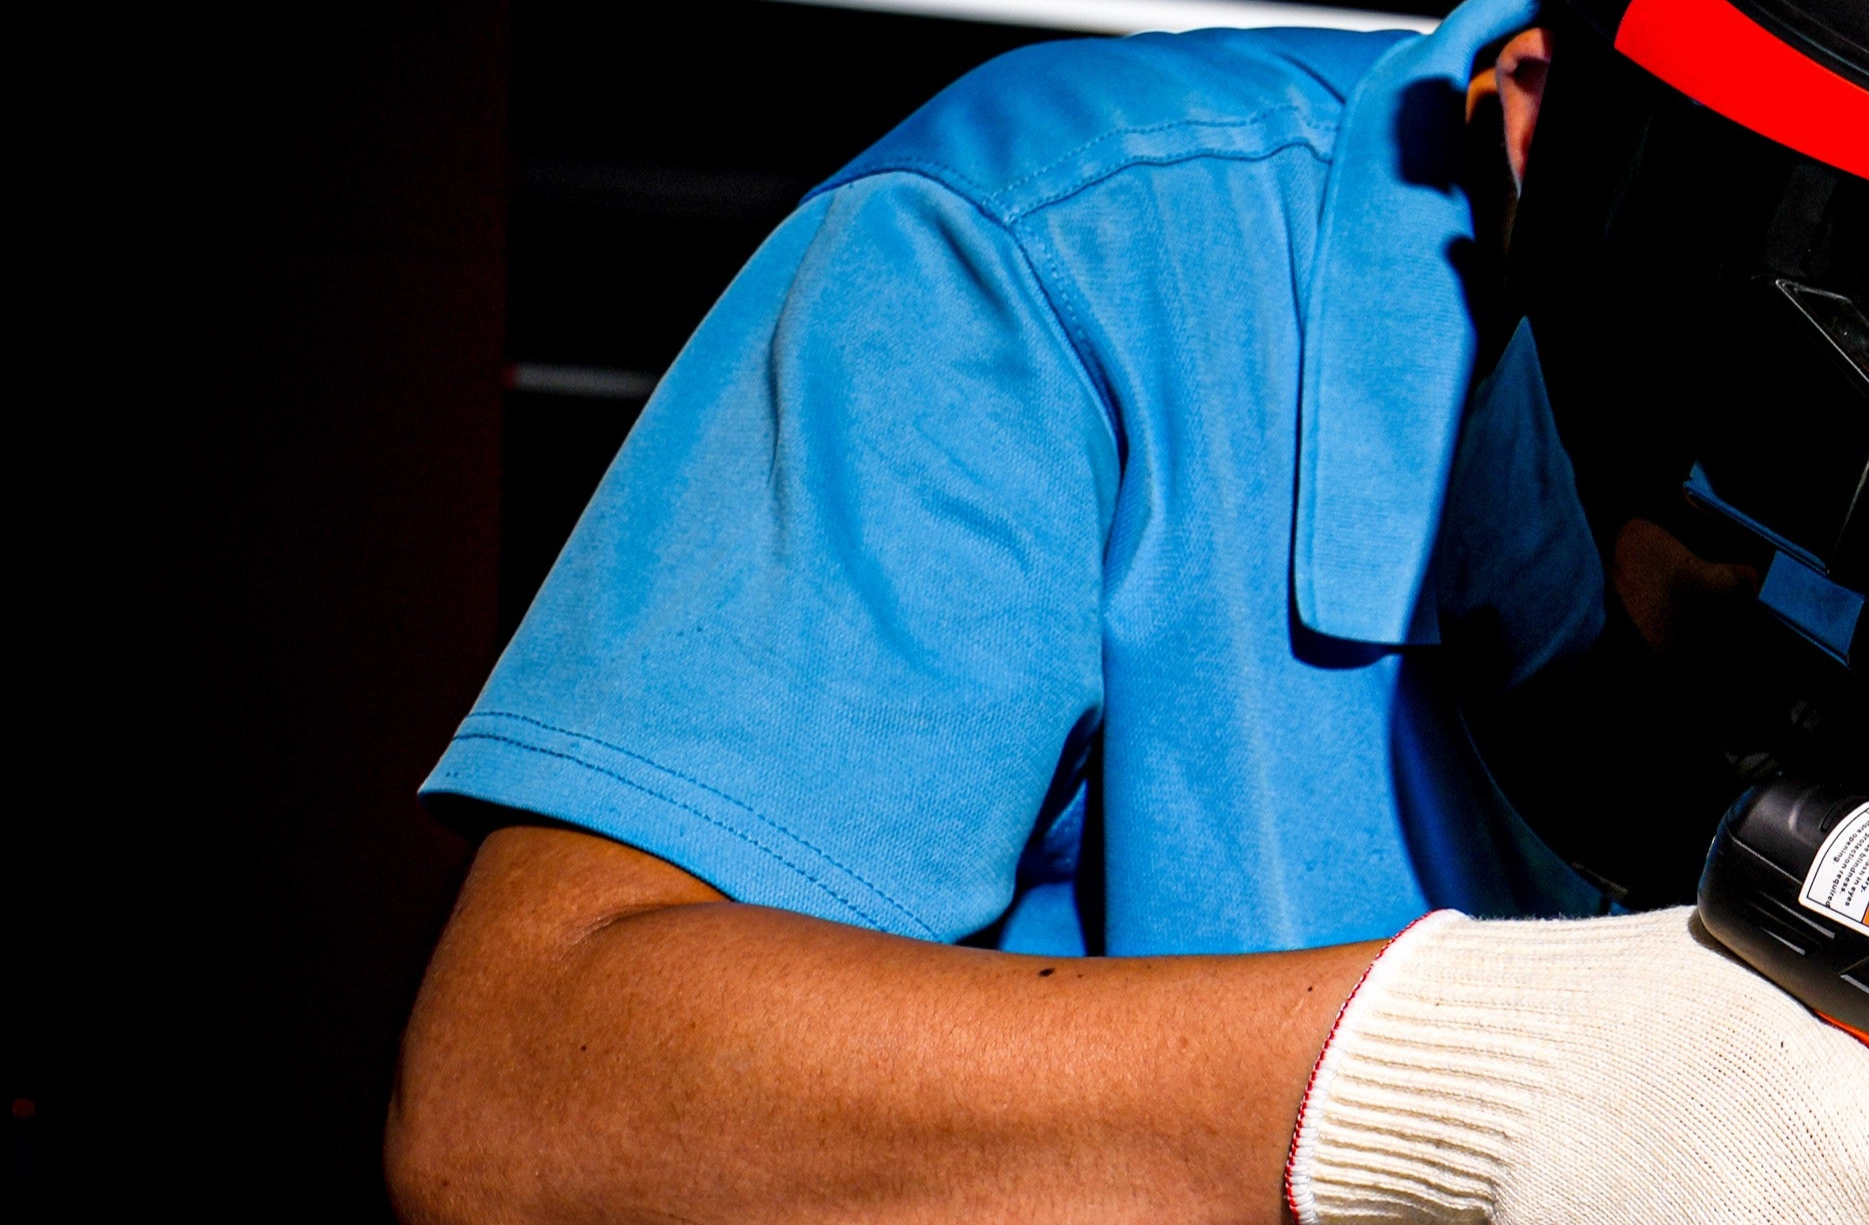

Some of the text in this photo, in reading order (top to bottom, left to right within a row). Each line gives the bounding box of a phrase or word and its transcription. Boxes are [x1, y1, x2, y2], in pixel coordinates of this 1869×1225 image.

[1841, 832, 1869, 869] protection
[1823, 870, 1844, 908] required
[1854, 876, 1862, 885] in
[1844, 886, 1856, 907] eyes
